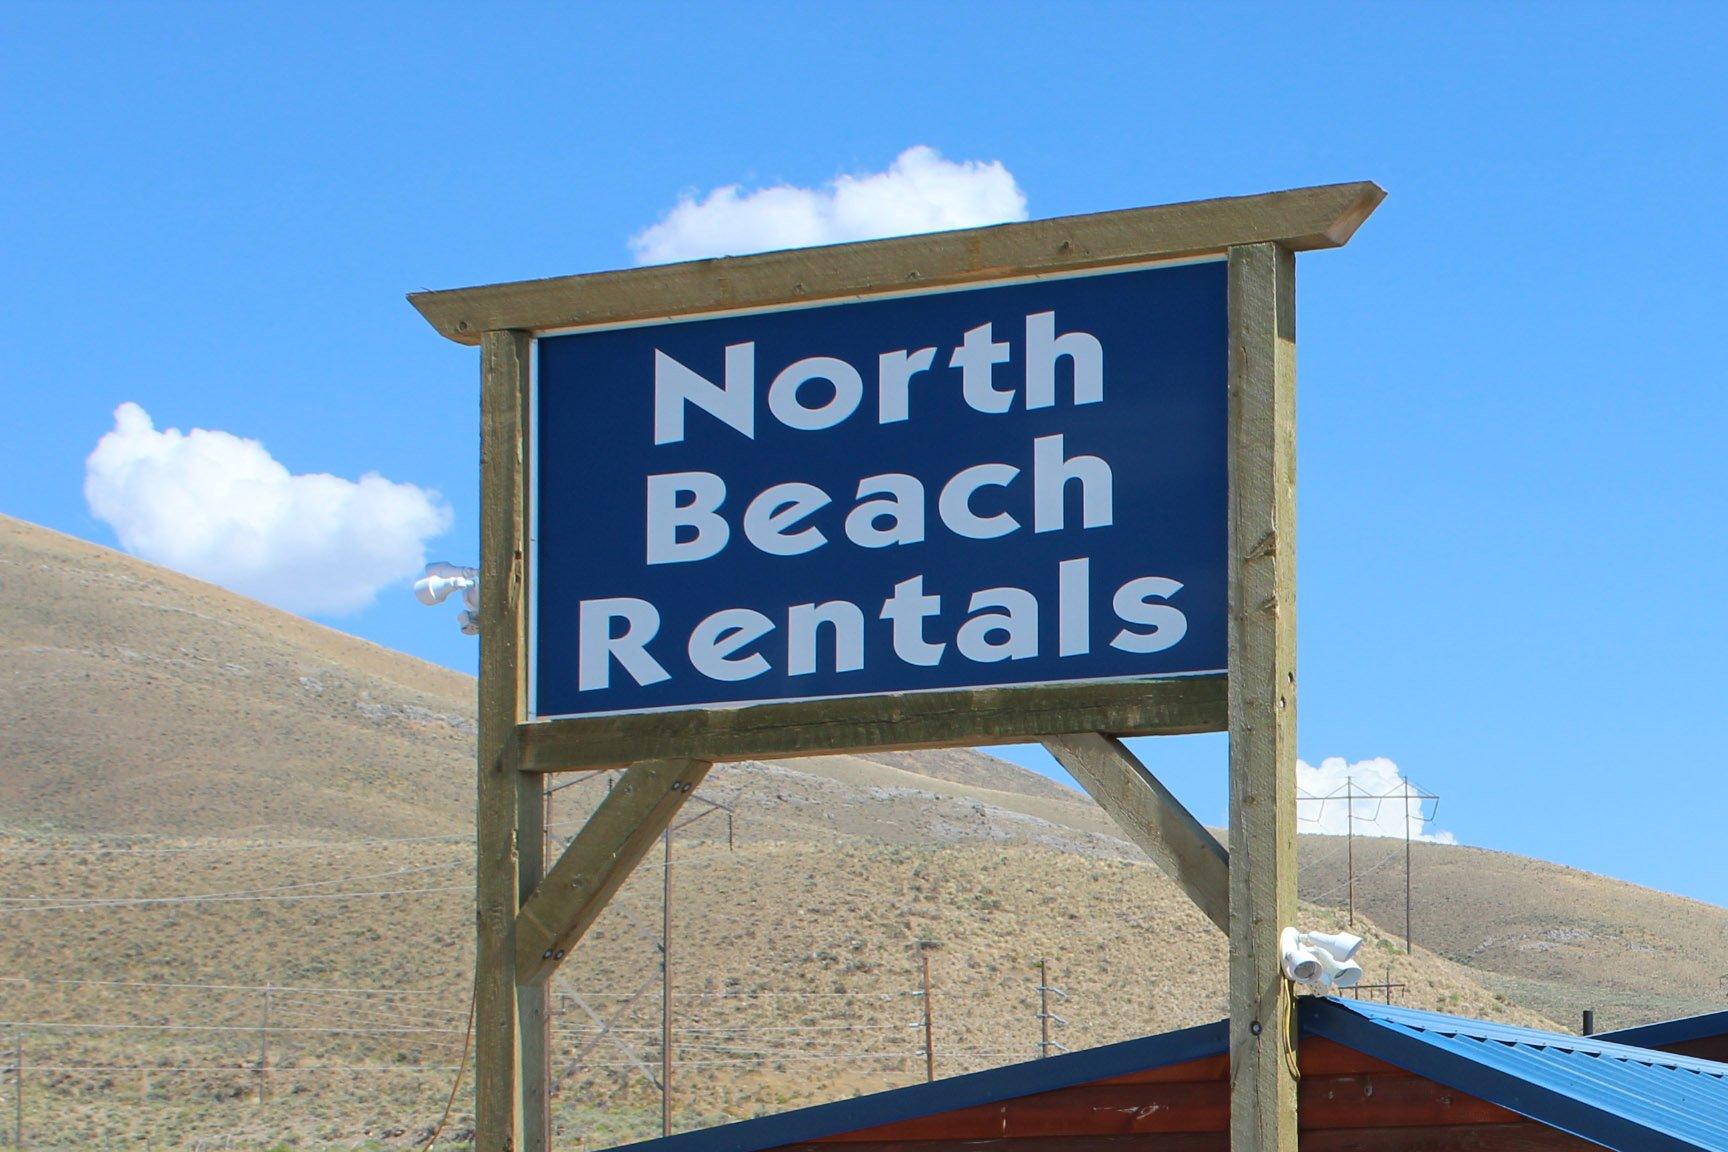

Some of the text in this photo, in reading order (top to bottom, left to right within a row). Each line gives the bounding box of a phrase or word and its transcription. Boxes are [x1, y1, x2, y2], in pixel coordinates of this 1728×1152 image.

[654, 311, 1105, 446] North
[646, 433, 1114, 566] Beach
[578, 557, 1188, 692] Rentals
